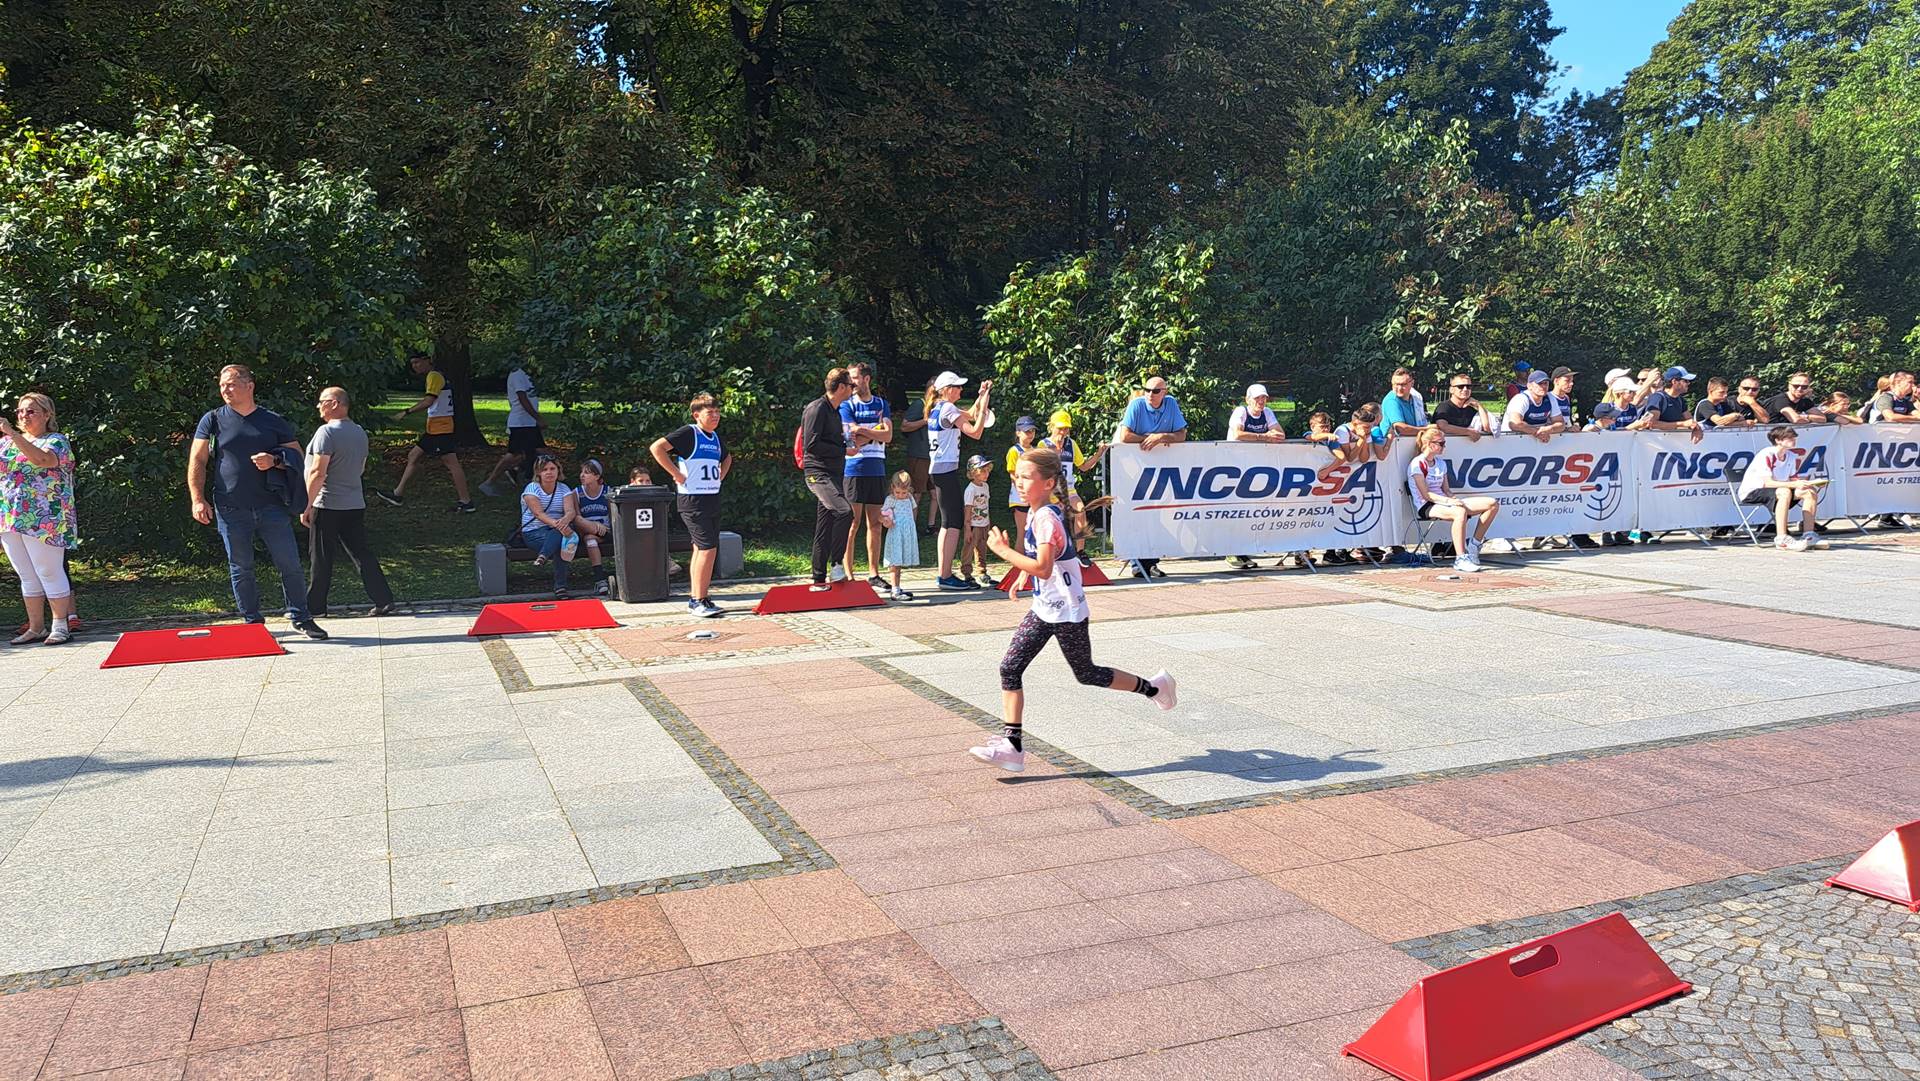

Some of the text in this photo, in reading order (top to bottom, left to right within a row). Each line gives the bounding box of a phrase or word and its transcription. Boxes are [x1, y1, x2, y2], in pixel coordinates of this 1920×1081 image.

[1852, 442, 1920, 469] INC
[1651, 445, 1827, 480] INCOA
[1445, 452, 1619, 489] NCORSA
[1131, 461, 1377, 500] INCORSA
[1876, 477, 1894, 486] DLA
[1679, 488, 1738, 498] DLA STRZE
[1495, 494, 1583, 506] ZELCÓW Z PASJĄ
[1173, 506, 1335, 521] DLA STRZELCÓW Z PASJĄ
[1511, 506, 1574, 517] od 1989 roku
[1250, 519, 1324, 531] od 1989 roku
